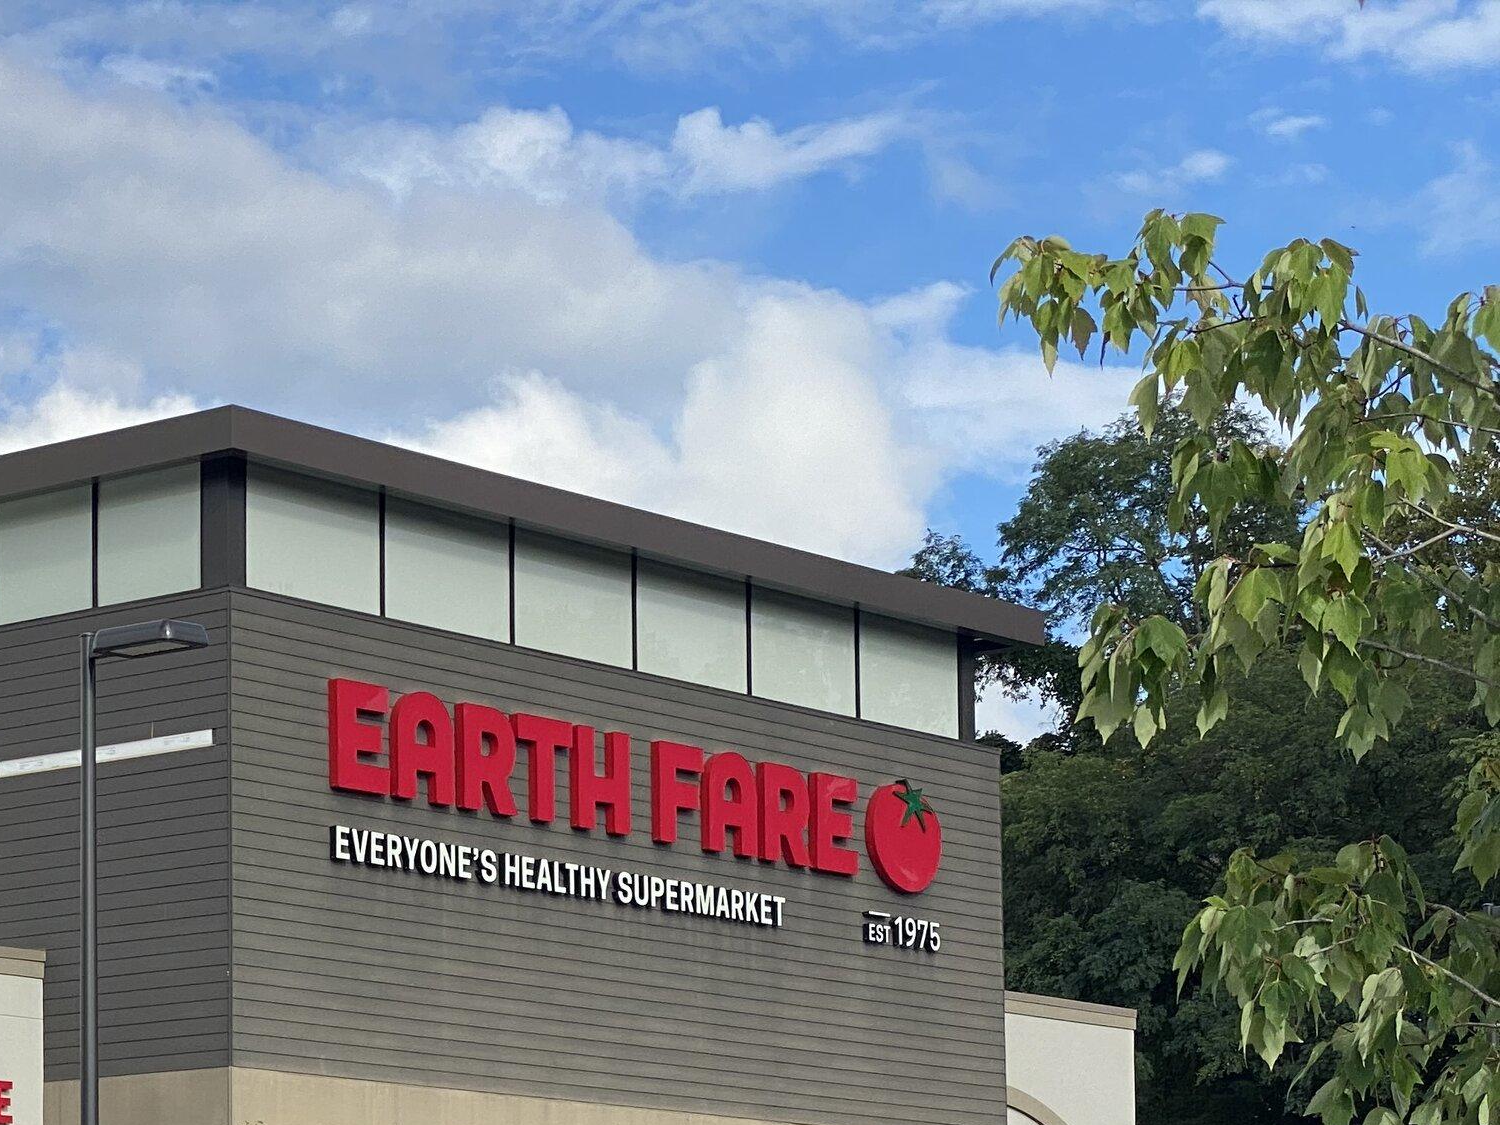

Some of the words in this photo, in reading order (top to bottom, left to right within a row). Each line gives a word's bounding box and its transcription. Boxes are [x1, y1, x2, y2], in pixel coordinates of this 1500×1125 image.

[328, 678, 631, 837] EARTH
[650, 740, 859, 876] FARE
[333, 825, 498, 883] EVERYONE'S
[503, 853, 611, 900] HEALTHY
[616, 872, 786, 927] SUPERMARKET
[867, 922, 891, 944] EST
[893, 915, 941, 952] 1975
